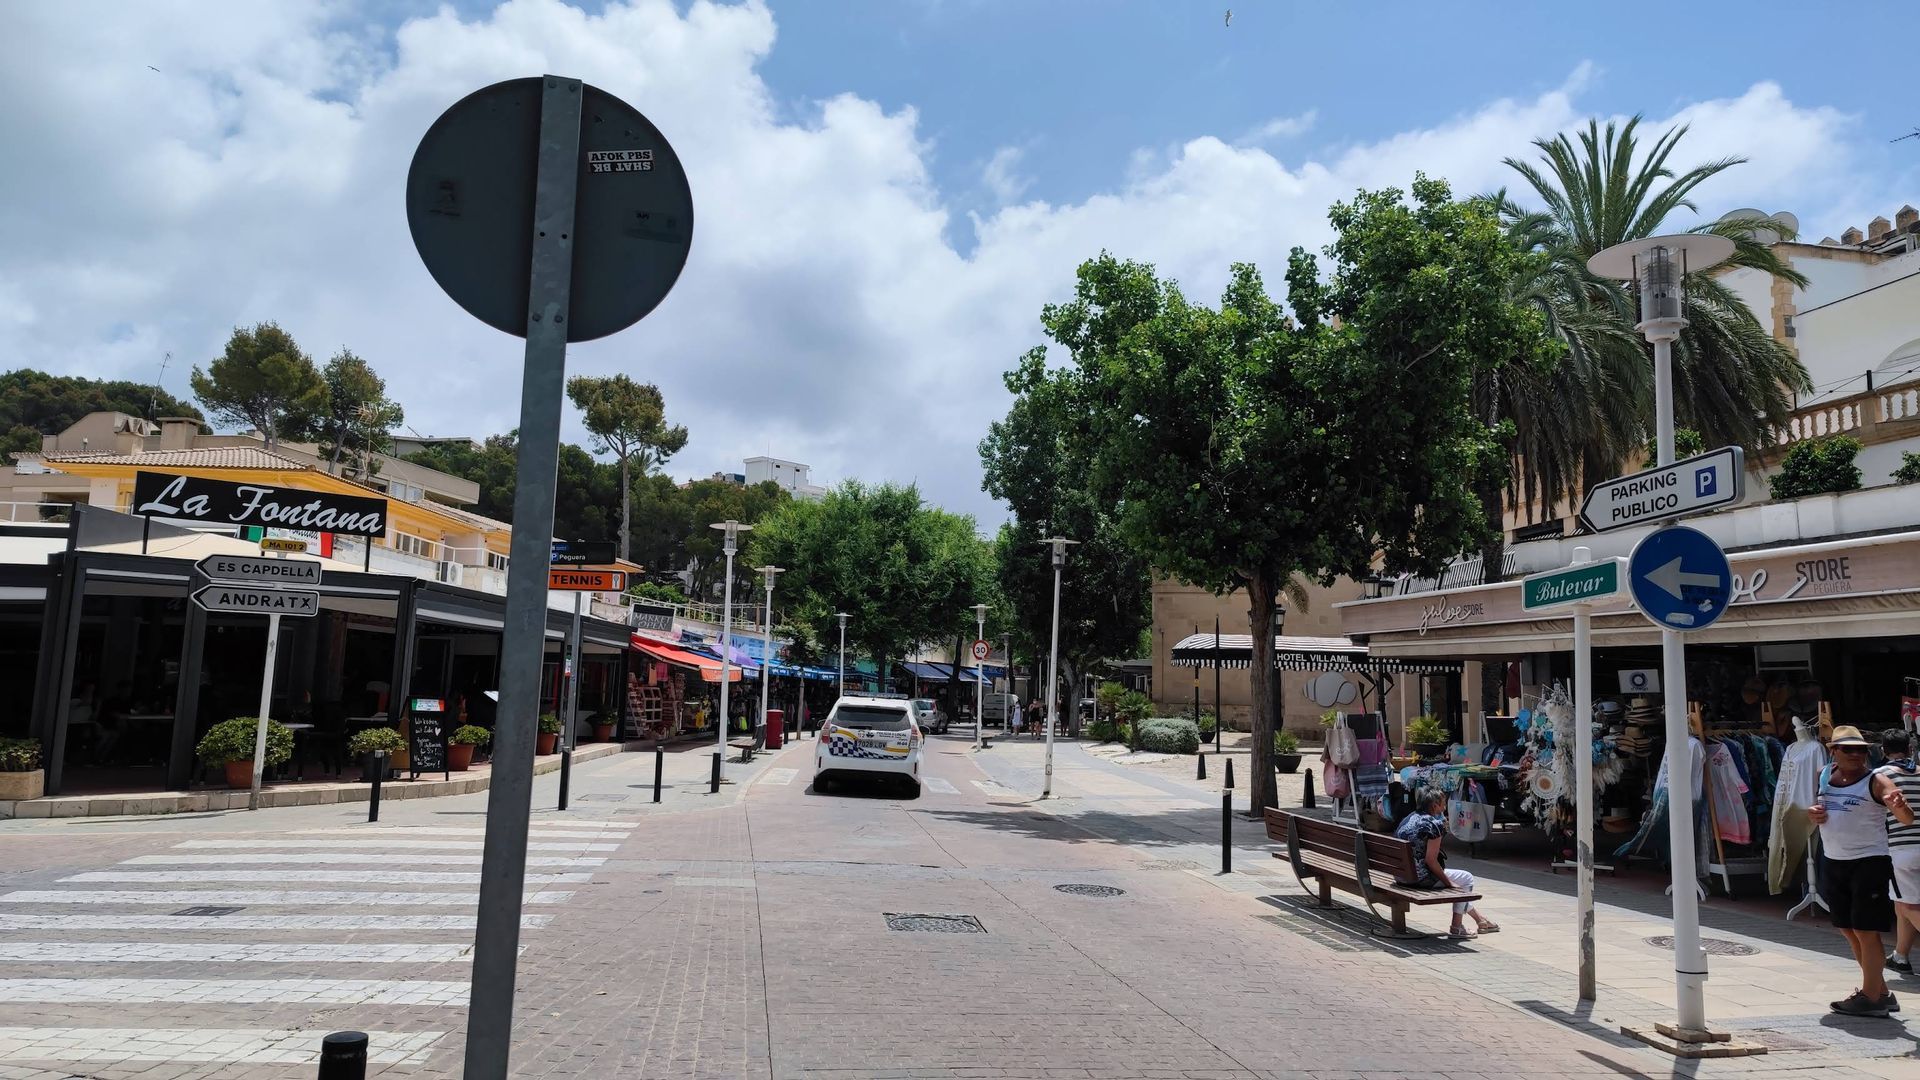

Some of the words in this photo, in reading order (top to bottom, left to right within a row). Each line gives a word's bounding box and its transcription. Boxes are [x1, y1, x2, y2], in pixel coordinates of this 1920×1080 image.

[628, 151, 650, 159] PBS
[1611, 472, 1677, 501] PARKING
[139, 476, 211, 516] La
[229, 486, 383, 533] Fontana
[1612, 494, 1678, 522] PUBLICO
[269, 541, 280, 549] MA
[217, 562, 236, 572] ES
[1795, 557, 1851, 582] STORE
[552, 575, 603, 585] TENNIS
[1536, 577, 1604, 602] Bulevar
[1813, 582, 1852, 593] PEGUERA
[219, 593, 312, 609] ANDRATX
[1463, 603, 1484, 616] STORE
[634, 612, 670, 624] MARKET
[638, 620, 667, 630] OPEN
[1276, 653, 1307, 662] HOTEL
[1310, 654, 1352, 663] VILLAMIL
